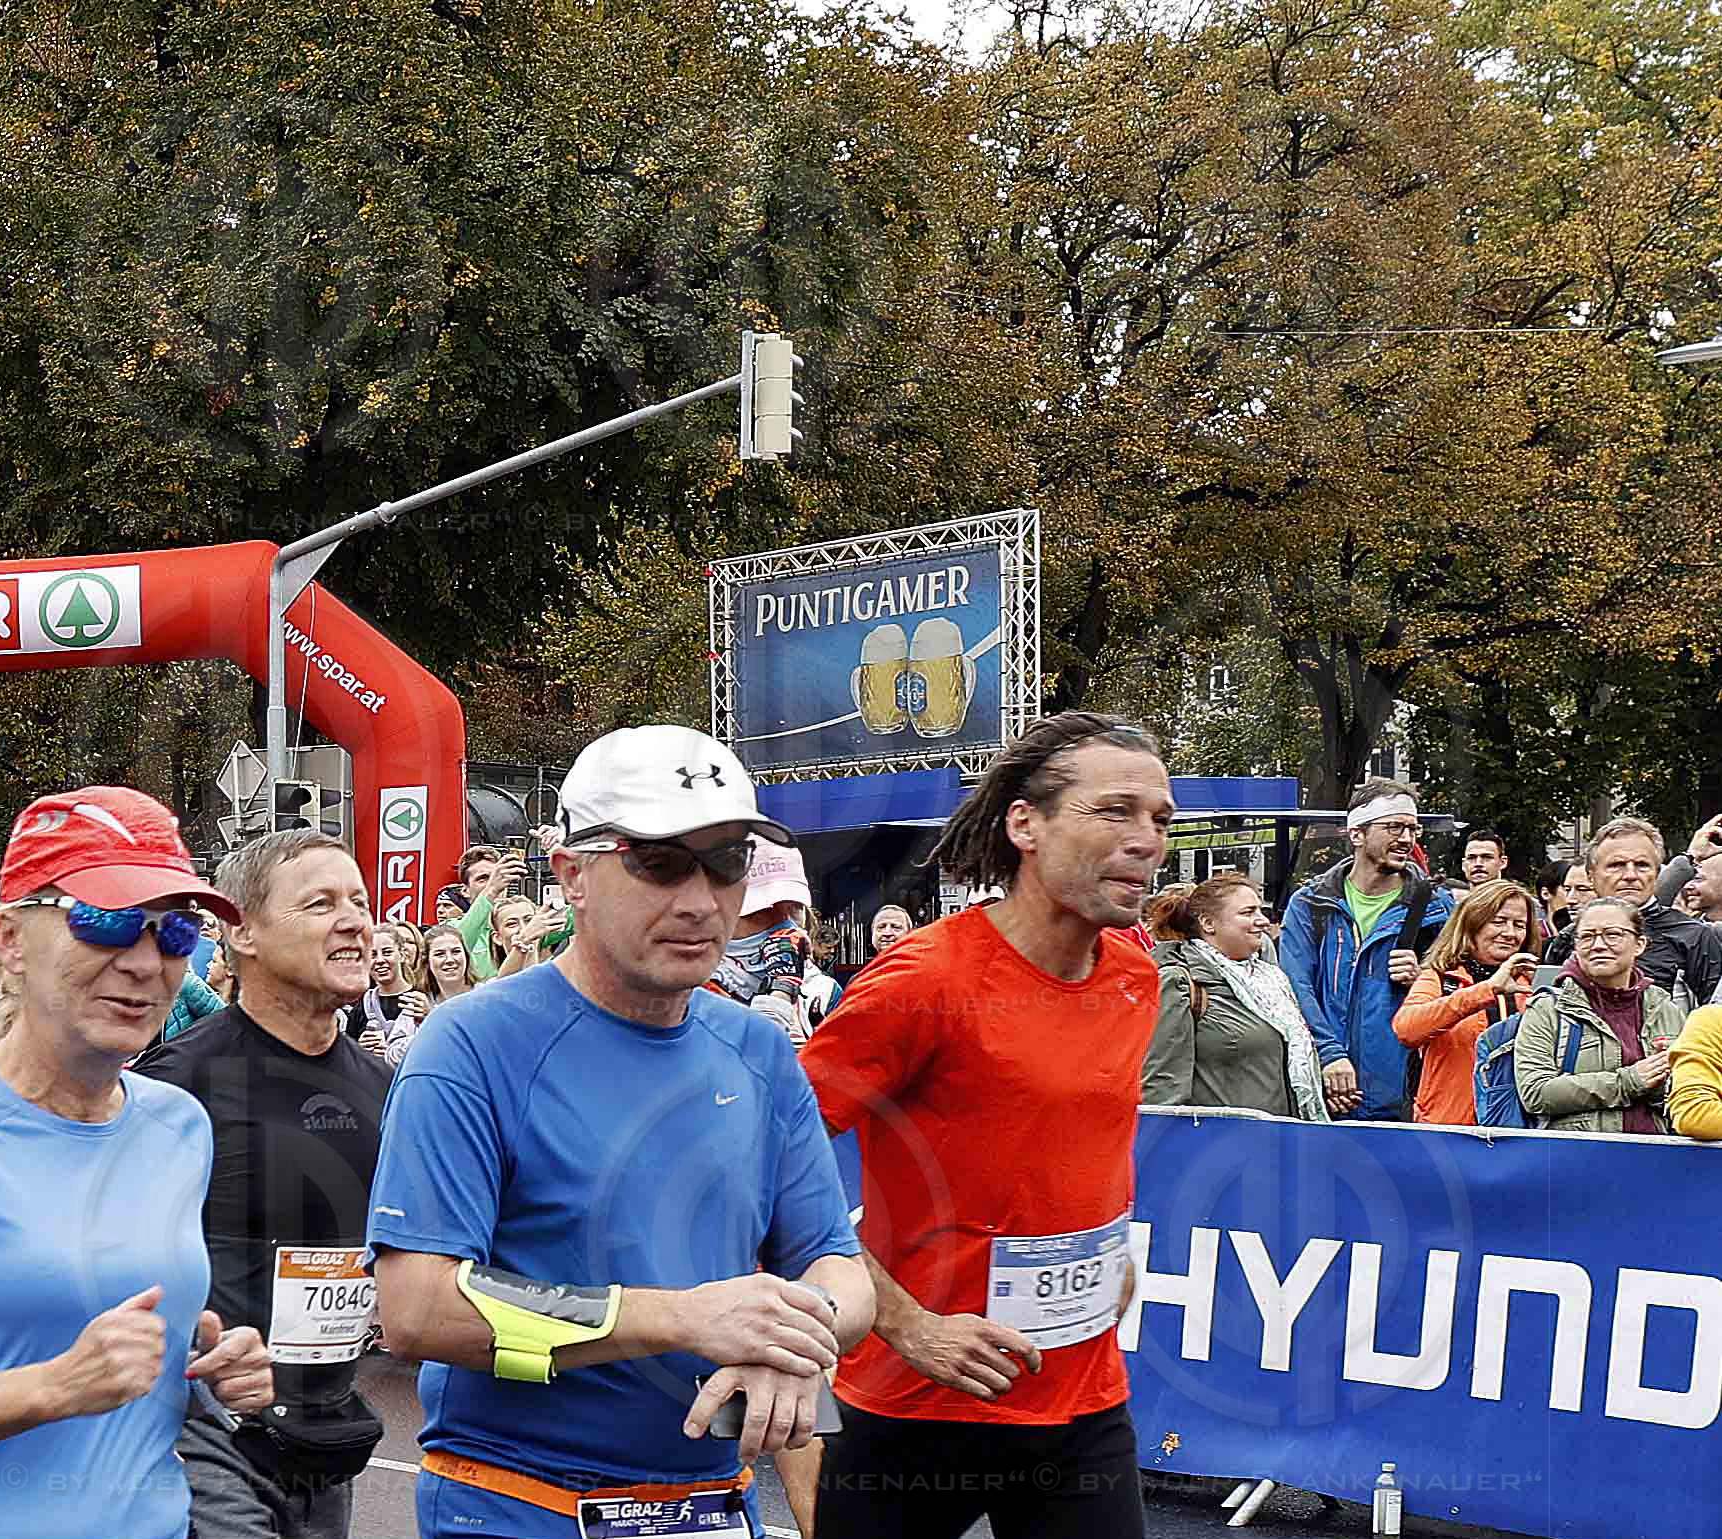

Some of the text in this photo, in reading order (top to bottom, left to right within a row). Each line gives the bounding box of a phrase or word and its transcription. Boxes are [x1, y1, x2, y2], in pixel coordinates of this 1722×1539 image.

[755, 565, 970, 638] PUNTIGAMER
[1036, 1260, 1102, 1298] 8162
[620, 1502, 663, 1517] GRAZ
